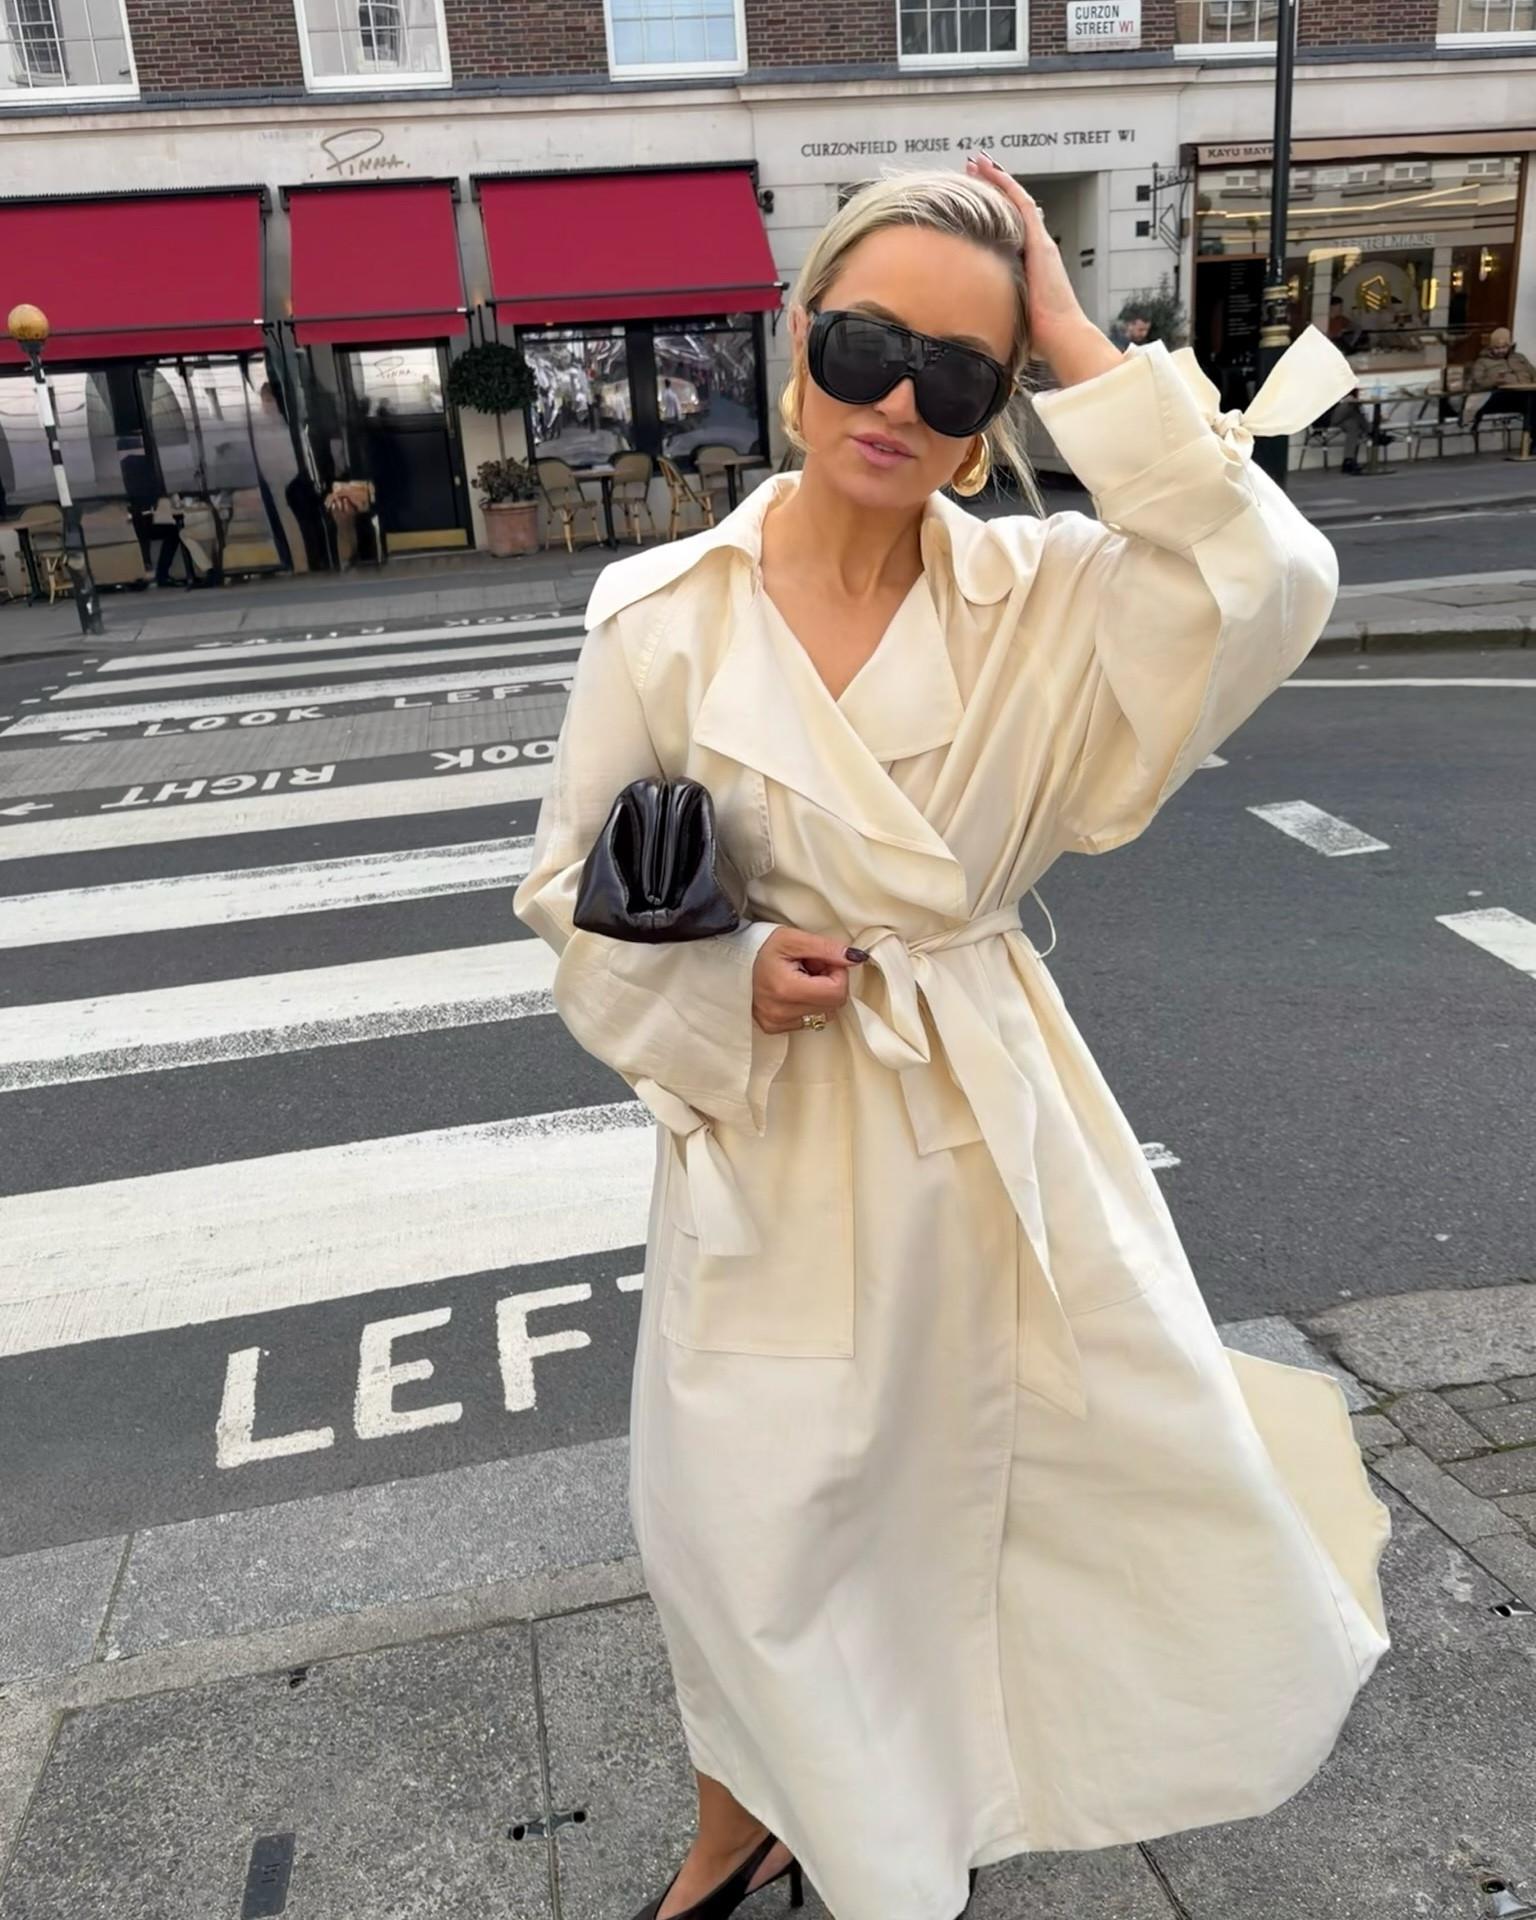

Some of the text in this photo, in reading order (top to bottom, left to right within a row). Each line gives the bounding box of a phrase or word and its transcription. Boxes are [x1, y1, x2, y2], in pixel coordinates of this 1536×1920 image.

[1075, 5, 1120, 20] CURZON
[1075, 20, 1134, 35] STREET W1
[801, 140, 898, 157] CURZONFIELD
[904, 138, 950, 153] HOUSE
[1001, 132, 1058, 148] CURZON
[1063, 130, 1111, 145] STREET
[1208, 148, 1241, 159] KAYU
[143, 706, 326, 737] LOOK
[101, 740, 558, 809] OOK RIGHT
[216, 1273, 644, 1469] LEF
